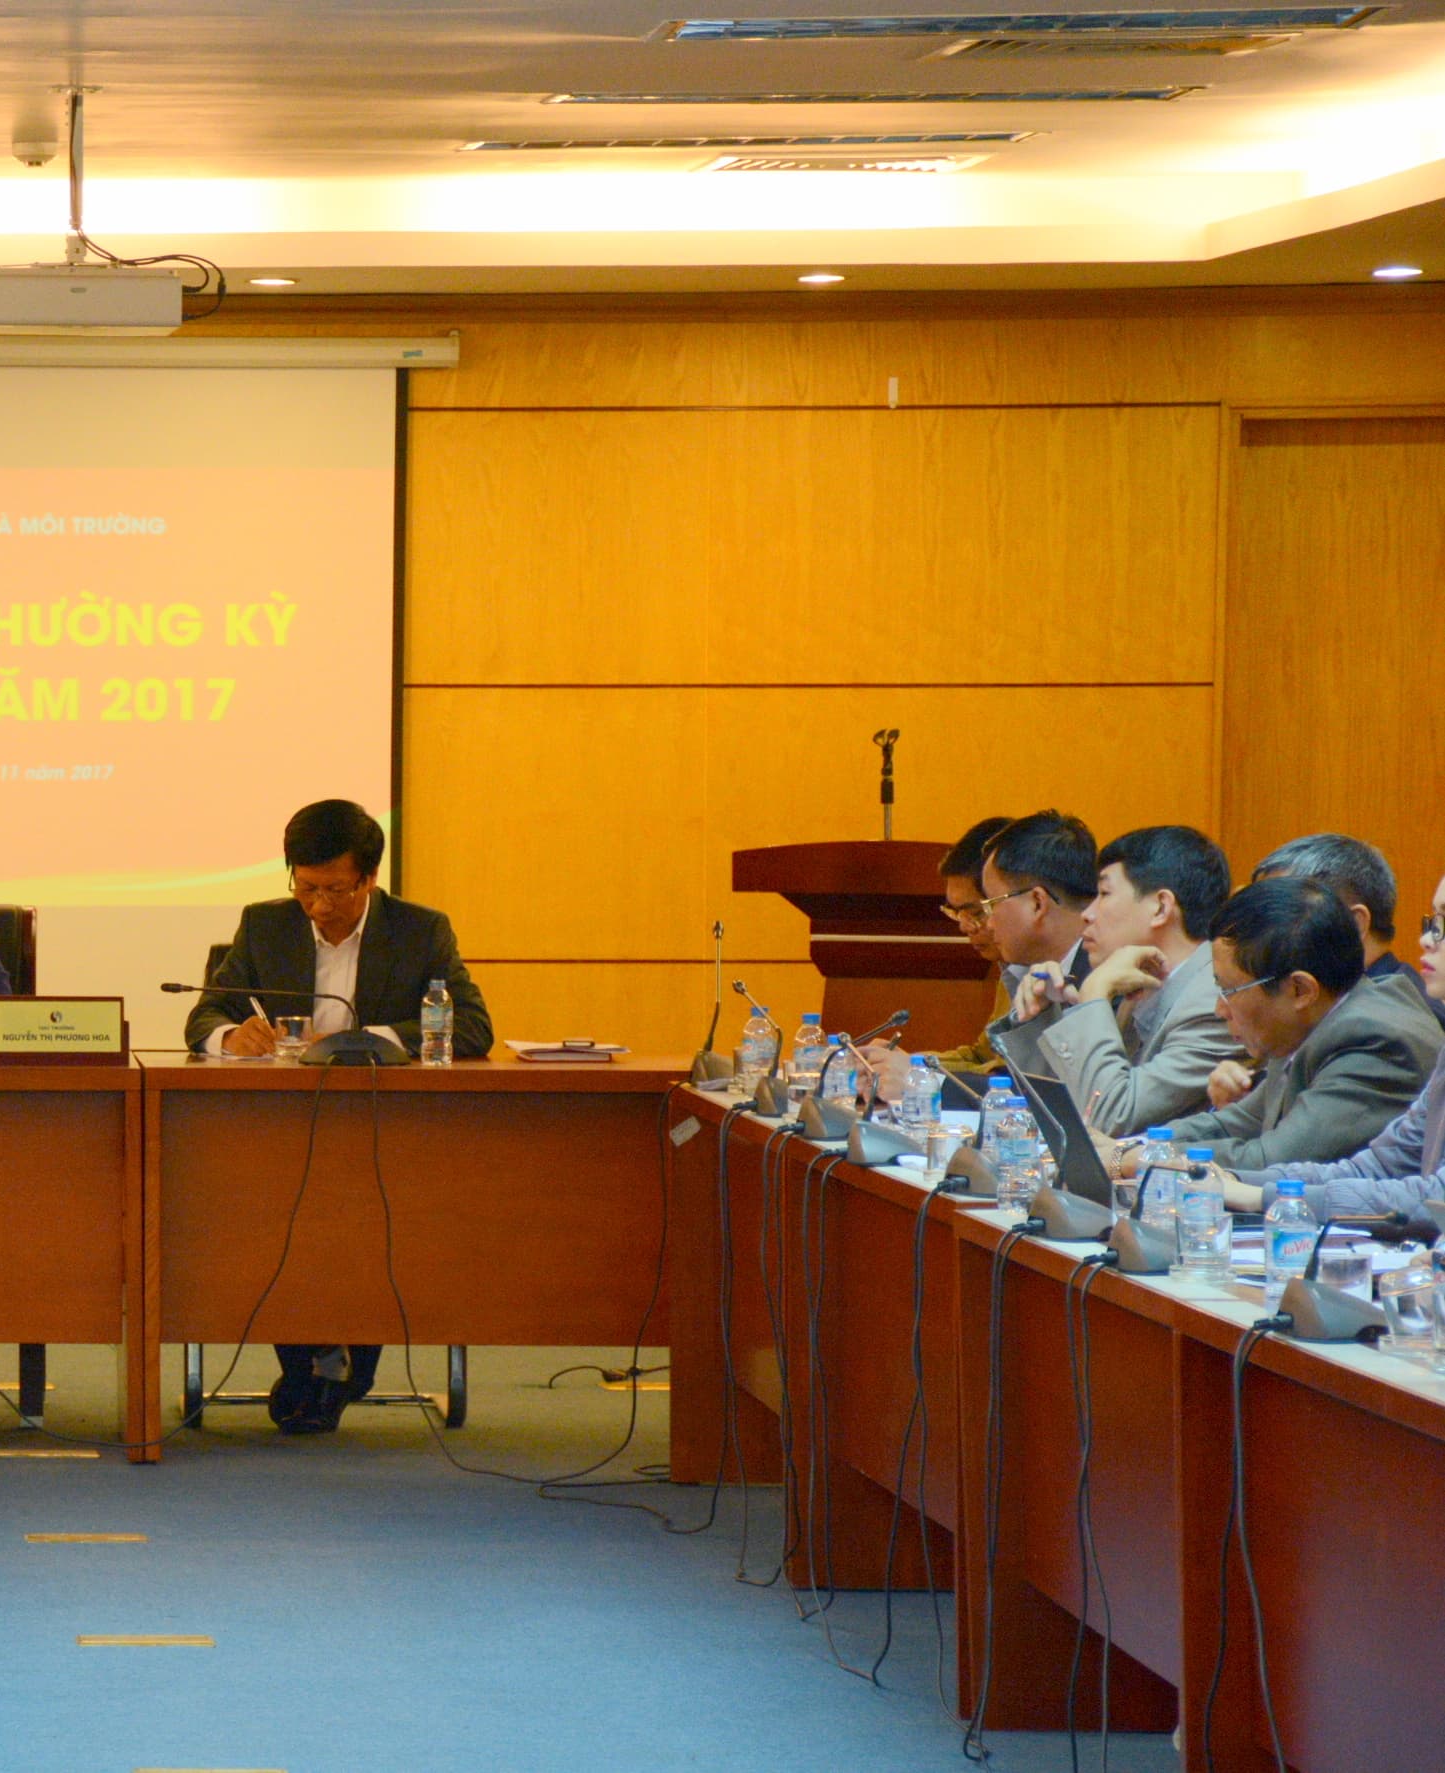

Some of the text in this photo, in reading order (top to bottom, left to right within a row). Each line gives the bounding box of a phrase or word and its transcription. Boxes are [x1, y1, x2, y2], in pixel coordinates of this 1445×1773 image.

[19, 512, 65, 535] MÔI
[71, 512, 167, 535] TRƯỜNG
[225, 590, 298, 647] KỲ
[100, 677, 237, 722] 2017
[25, 764, 65, 781] năm
[71, 764, 115, 782] 2017
